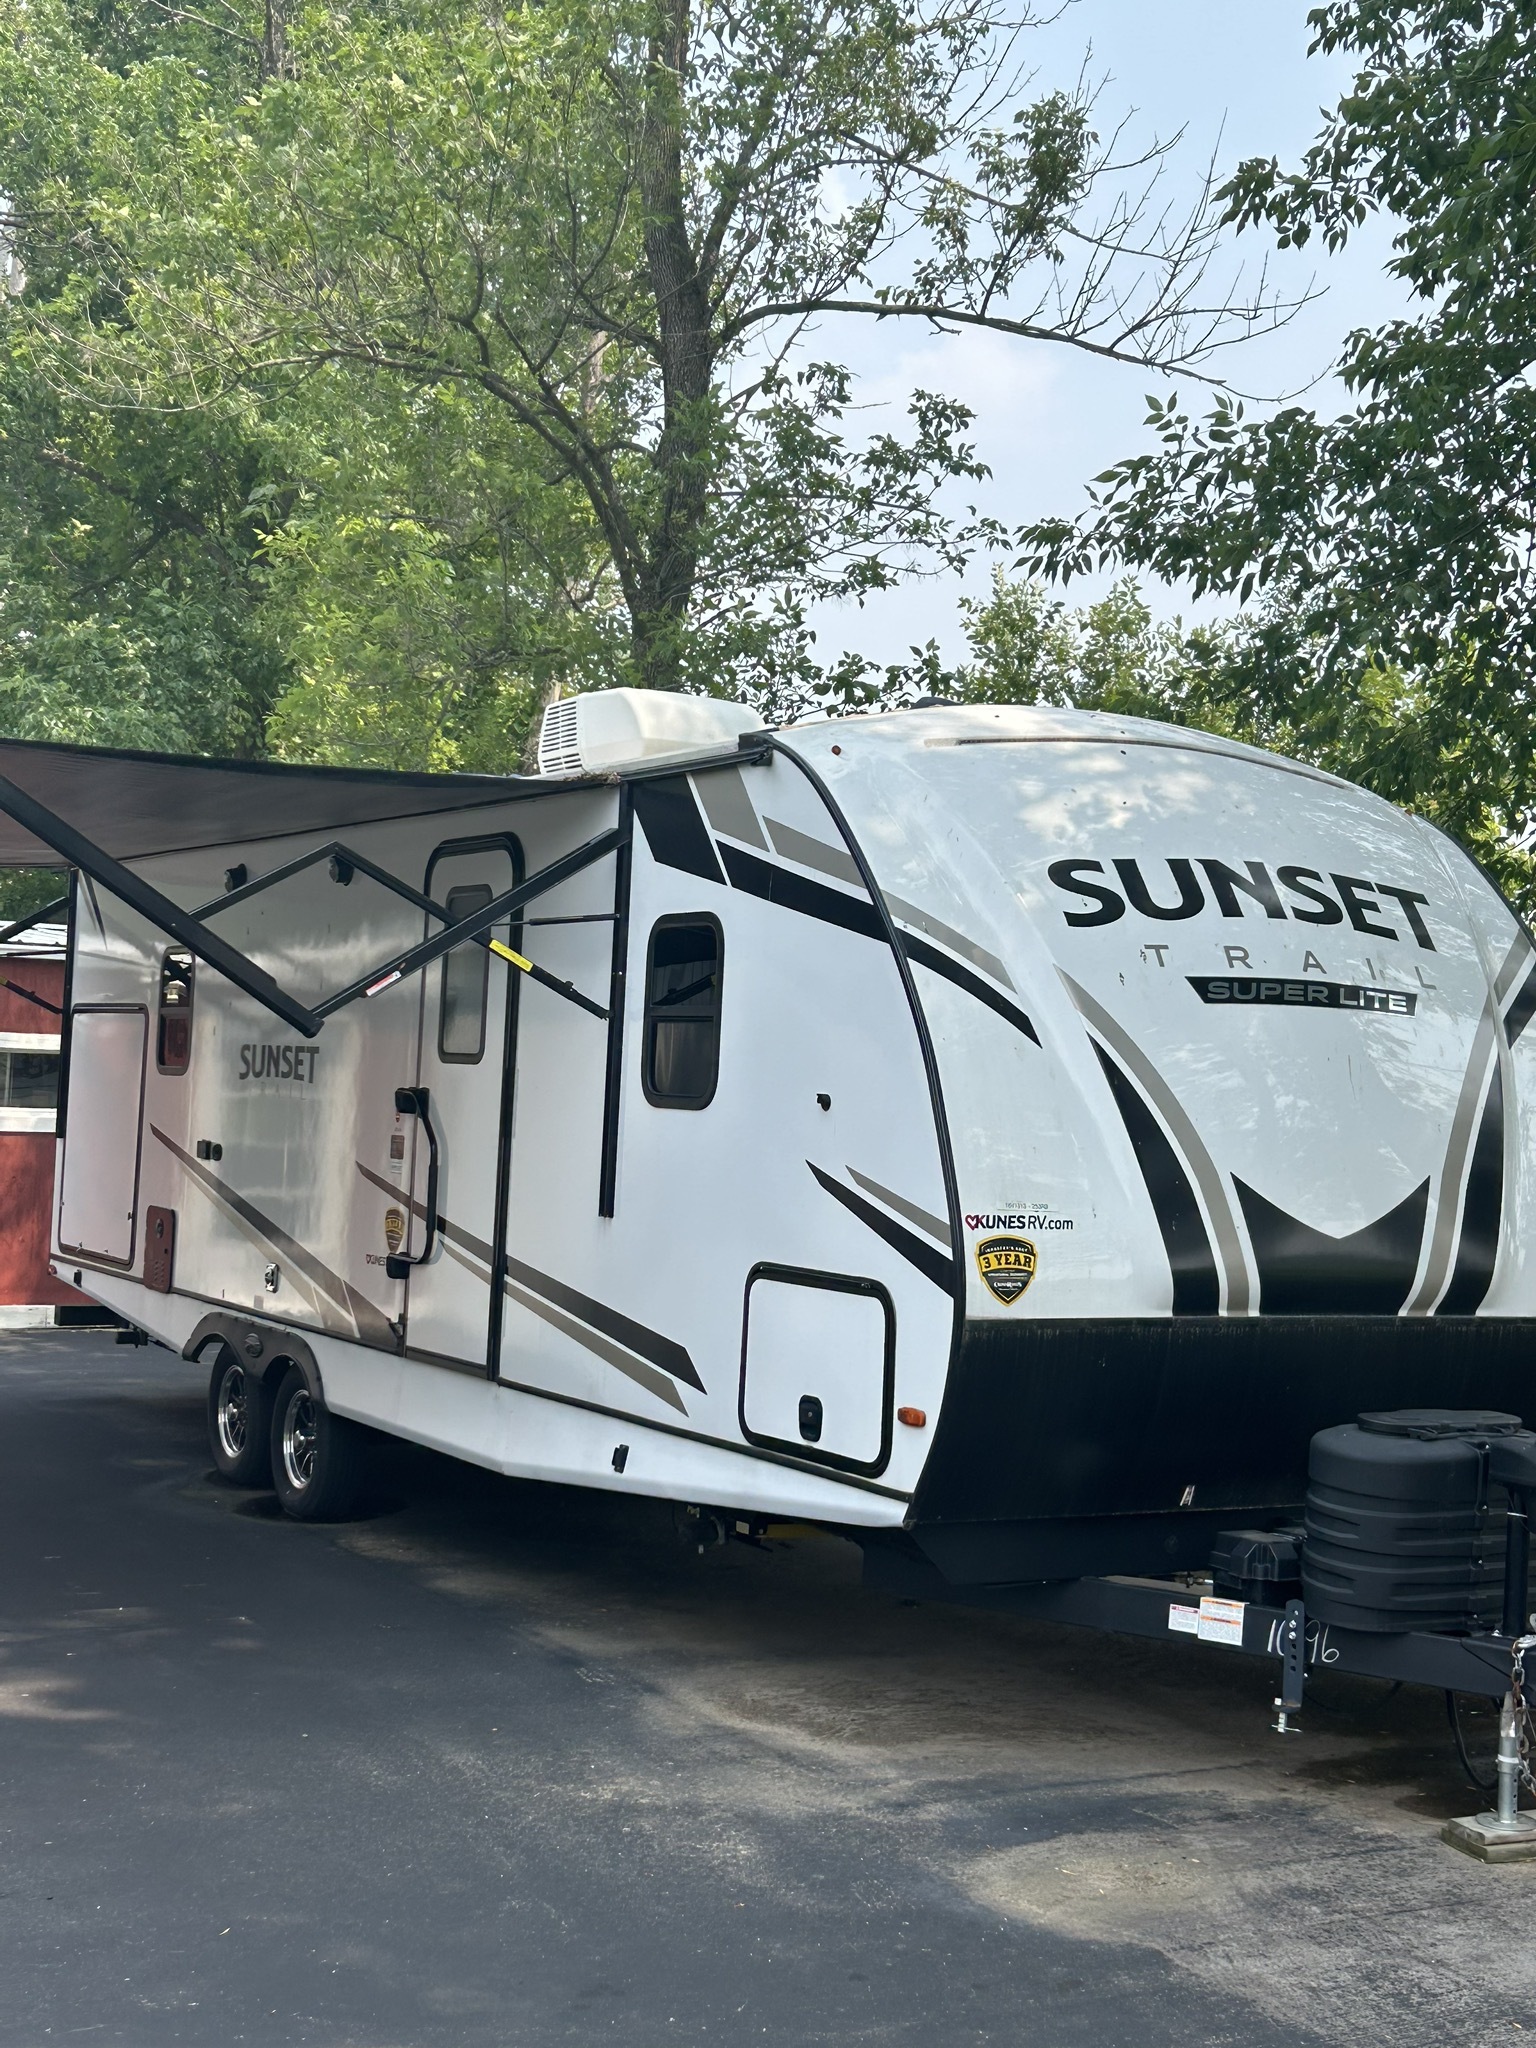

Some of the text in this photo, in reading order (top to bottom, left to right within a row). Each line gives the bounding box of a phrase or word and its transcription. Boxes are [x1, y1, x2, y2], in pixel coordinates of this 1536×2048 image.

[1047, 858, 1437, 952] SUNSET
[1144, 944, 1437, 990] TRAIL
[1207, 981, 1408, 1013] SUPER LITE
[239, 1043, 320, 1084] SUNSET
[982, 1253, 1032, 1269] 3 YEAR
